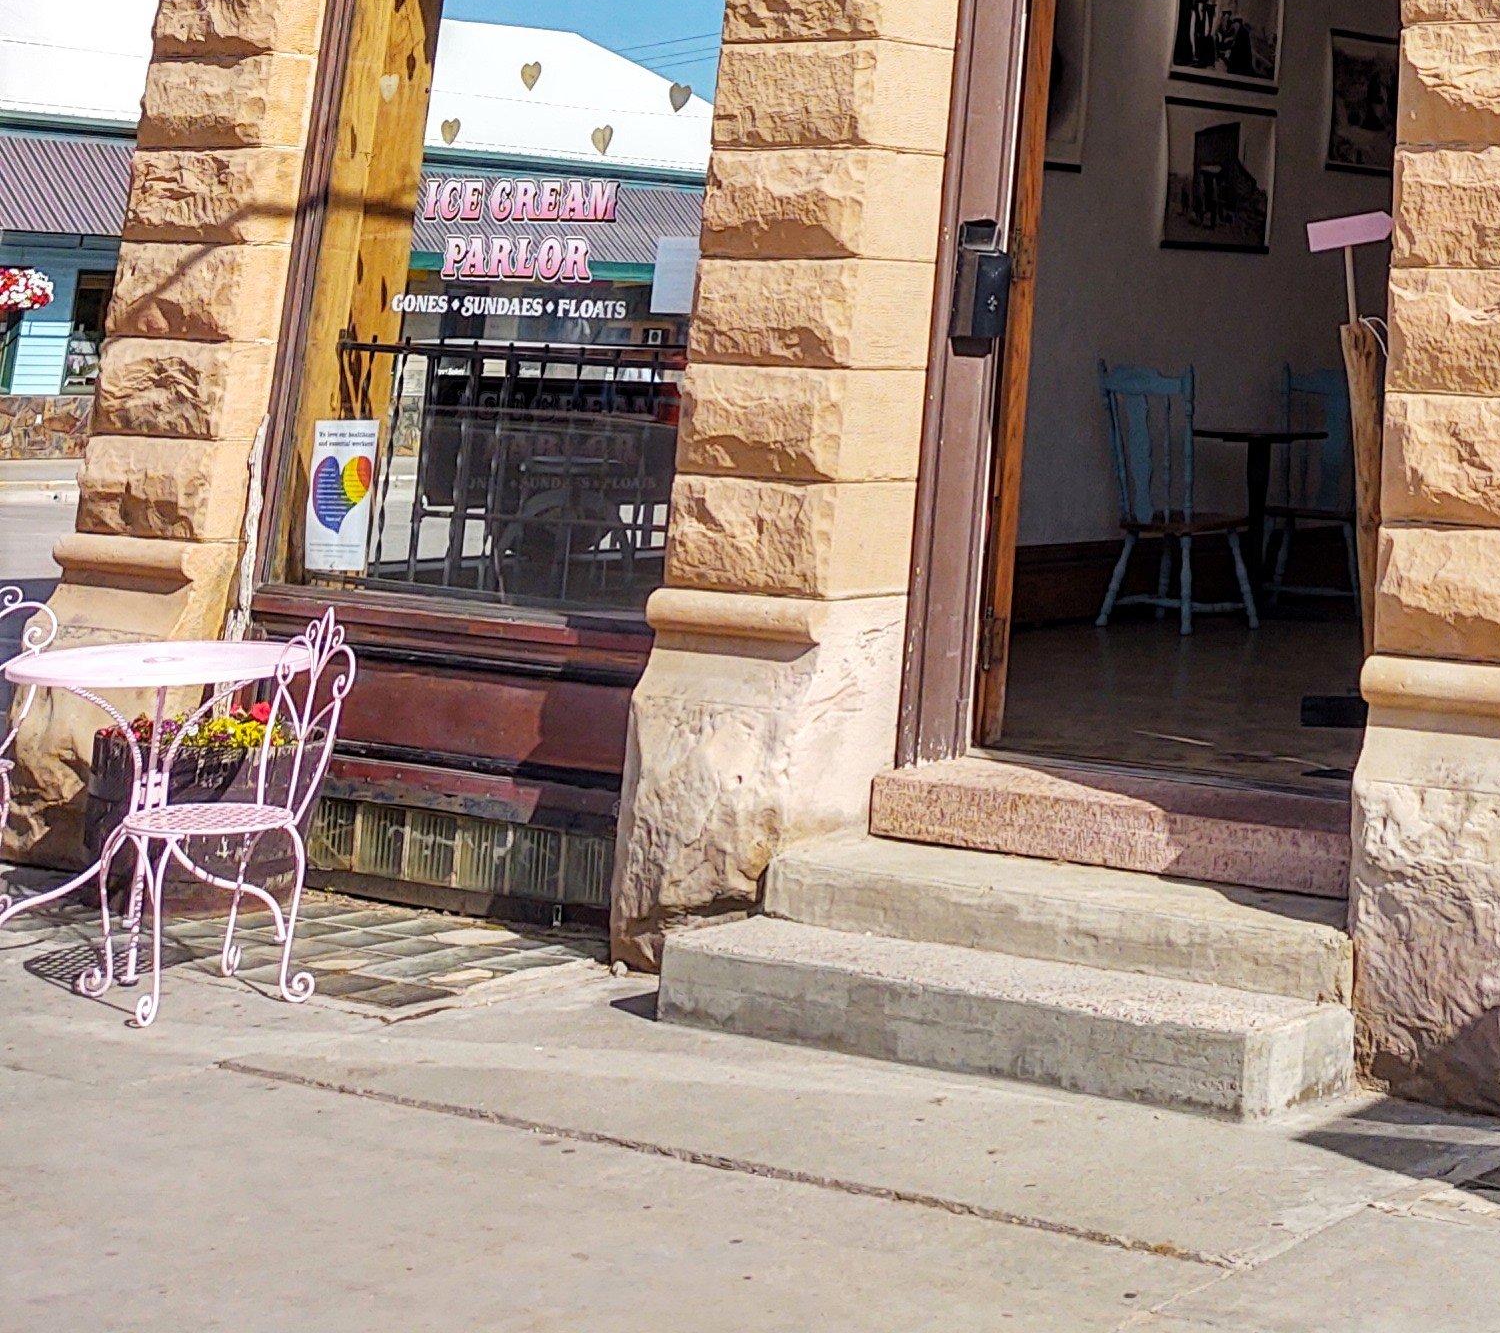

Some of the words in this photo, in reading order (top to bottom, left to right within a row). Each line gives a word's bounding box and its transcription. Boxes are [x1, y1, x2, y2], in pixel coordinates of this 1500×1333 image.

[423, 178, 484, 222] ICE
[489, 177, 621, 224] CREAM
[440, 234, 592, 282] PARLOR
[391, 293, 448, 314] CONES
[460, 294, 544, 317] SUNDAES
[556, 298, 627, 320] FLOATS
